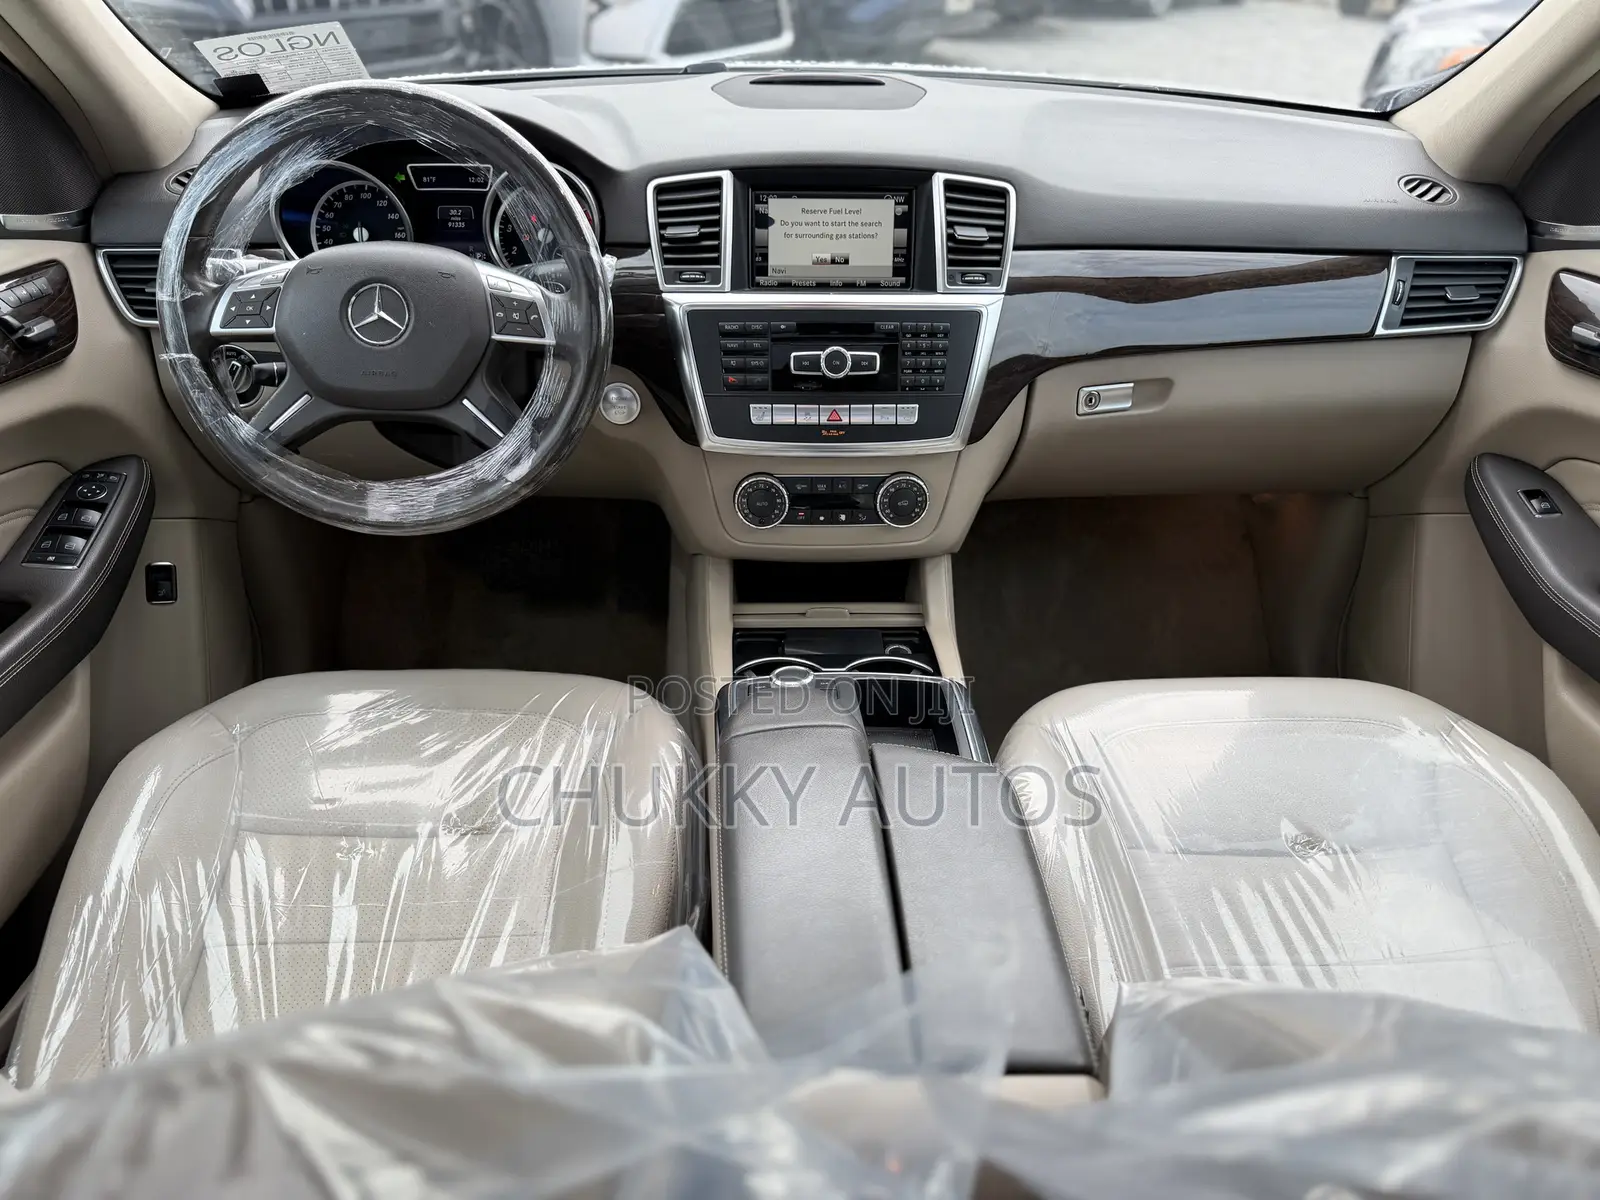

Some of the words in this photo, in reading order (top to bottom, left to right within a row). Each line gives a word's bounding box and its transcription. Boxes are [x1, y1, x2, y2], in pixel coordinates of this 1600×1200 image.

[333, 201, 342, 209] 70
[801, 207, 828, 215] Reserve
[829, 207, 843, 215] Fuel
[780, 219, 789, 227] Do
[783, 231, 793, 239] for
[795, 232, 834, 240] surrounding
[835, 233, 847, 241] gas
[511, 246, 518, 254] 2
[815, 255, 828, 263] Yes
[772, 267, 787, 275] Navi
[791, 279, 817, 287] Presets
[829, 279, 843, 287] Info
[856, 279, 867, 287] FM
[880, 279, 901, 287] Sound
